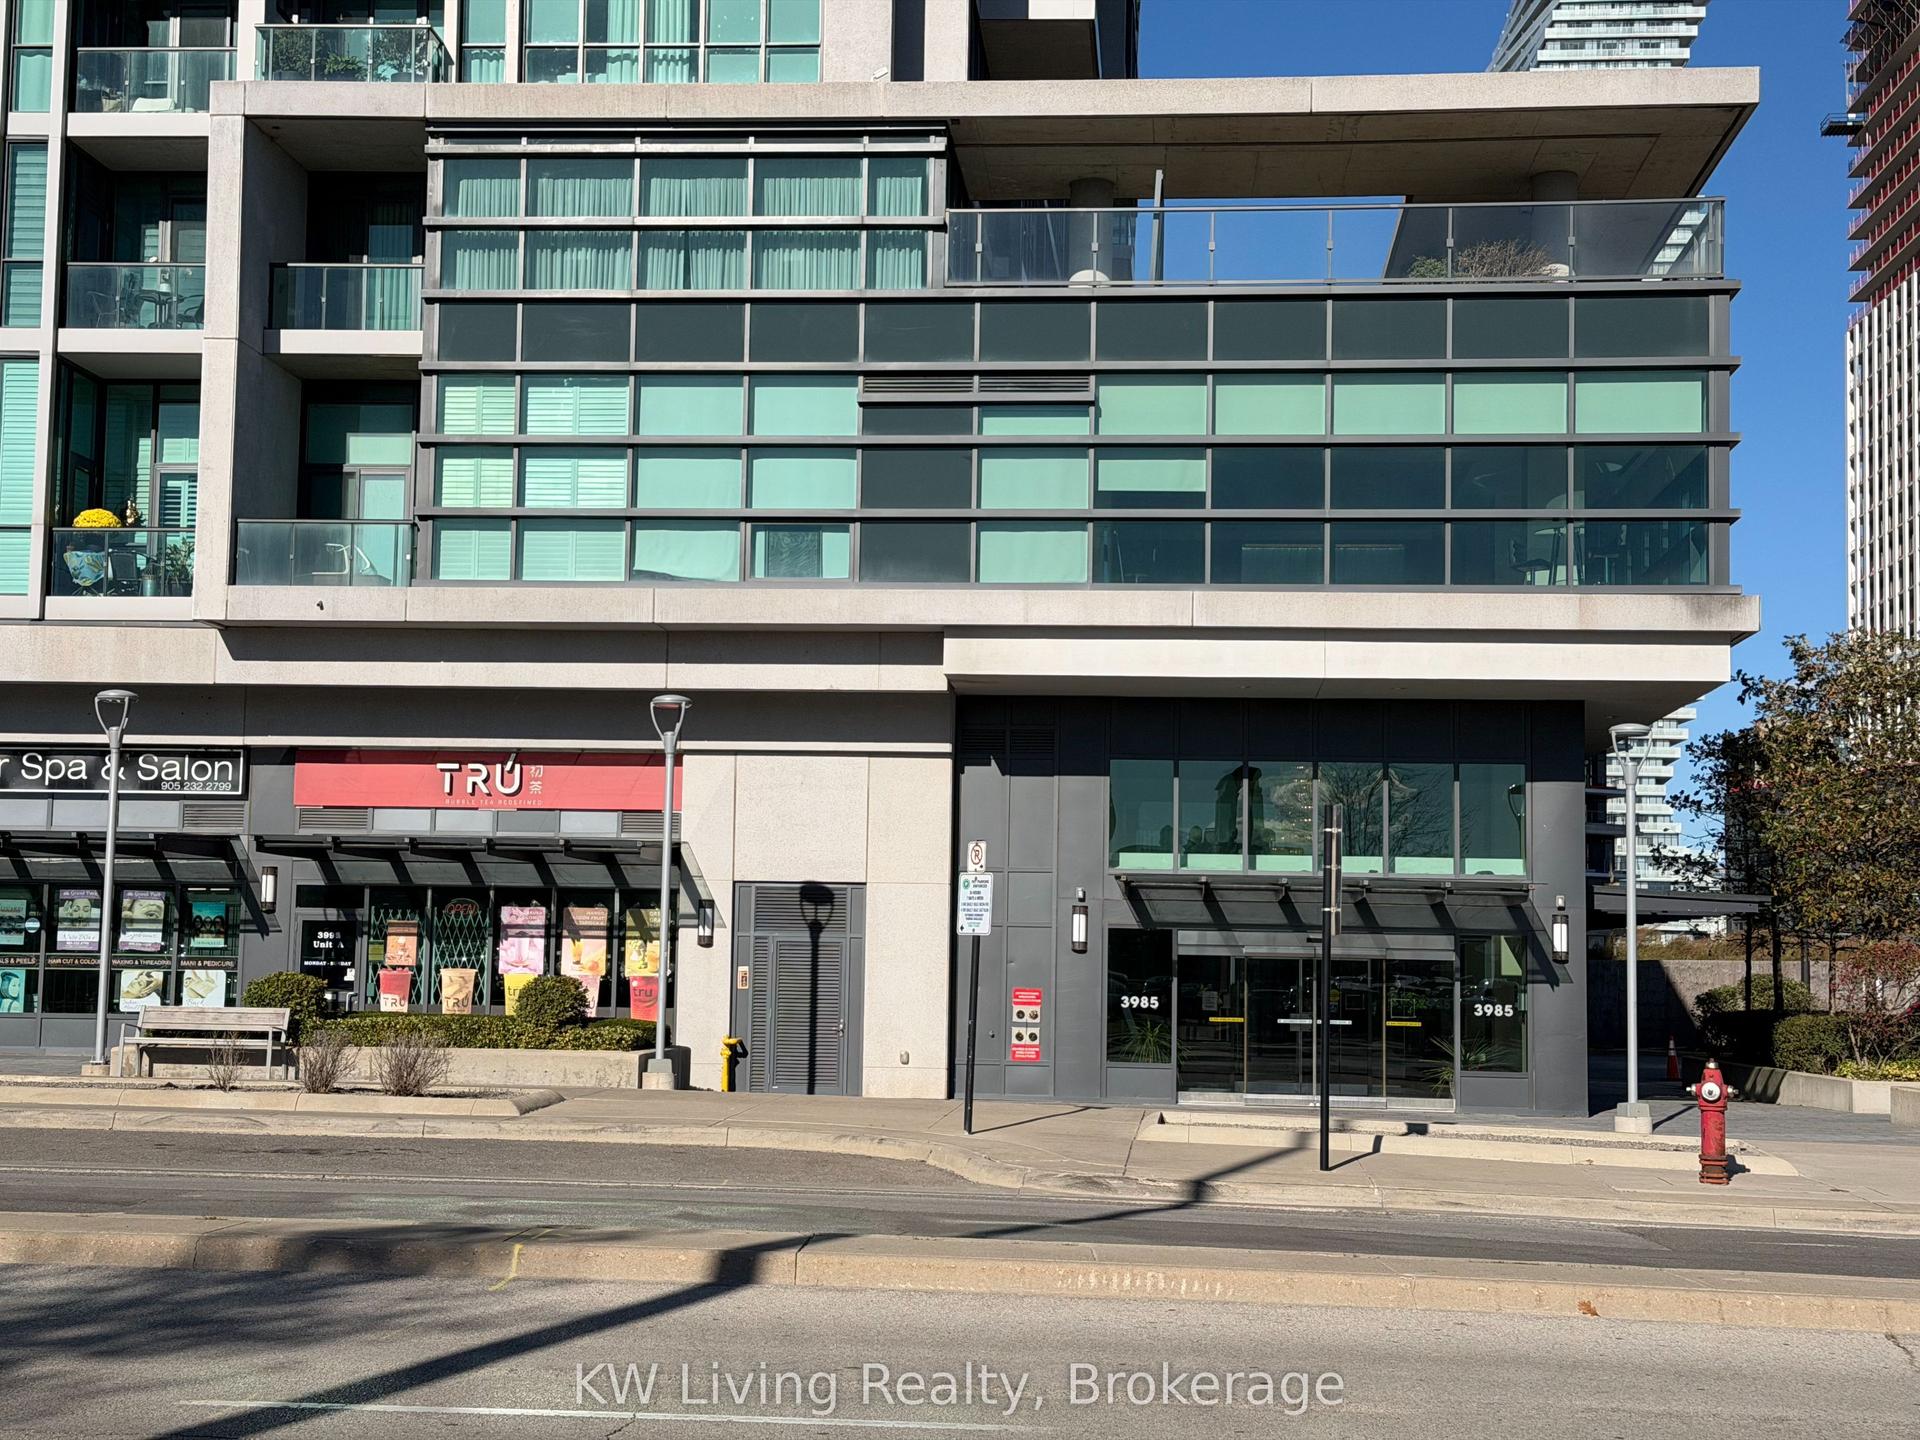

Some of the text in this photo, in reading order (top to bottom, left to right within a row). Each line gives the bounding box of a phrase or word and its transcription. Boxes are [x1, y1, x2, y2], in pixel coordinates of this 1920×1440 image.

[21, 752, 88, 786] Spa
[101, 754, 126, 780] &
[137, 753, 233, 781] Salon
[313, 940, 333, 948] Unit
[632, 987, 654, 997] tru
[1120, 995, 1160, 1010] 3985
[1473, 1003, 1514, 1018] 3985
